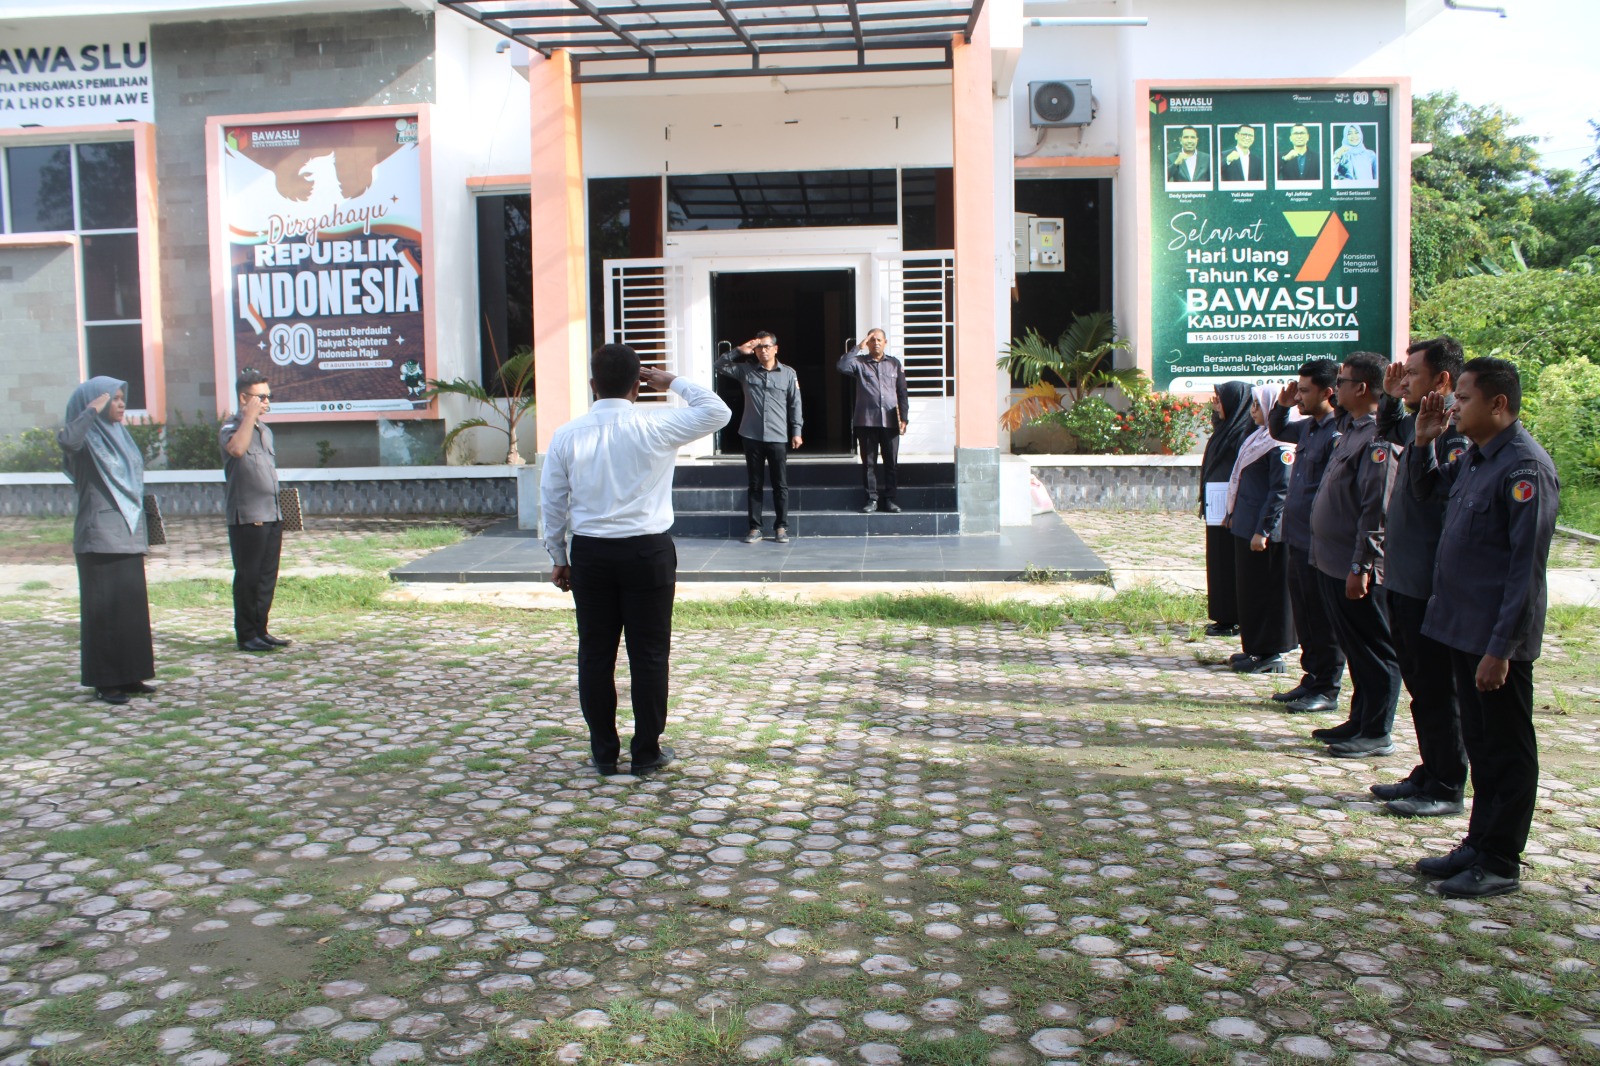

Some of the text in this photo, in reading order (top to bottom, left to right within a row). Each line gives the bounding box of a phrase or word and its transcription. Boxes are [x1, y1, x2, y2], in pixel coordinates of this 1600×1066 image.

[0, 42, 147, 74] AWASLU
[18, 80, 84, 91] PENGAWAS
[86, 76, 148, 89] PEMILIHAN
[20, 92, 149, 109] LHOKSEUMAWE
[1169, 97, 1213, 106] BAWASLU
[251, 129, 300, 141] BAWASLU
[267, 203, 388, 246] Dirgahayu
[1168, 211, 1267, 250] Selamat
[254, 238, 399, 267] REPUBLIK
[1186, 248, 1289, 266] Hari Ulang
[1186, 268, 1248, 283] Tahun
[1254, 268, 1279, 283] Ke
[237, 265, 420, 320] INDONESIA
[1186, 286, 1358, 312] BAWASLU
[1187, 311, 1359, 329] KABUPATEN/KOTA
[316, 325, 392, 337] Bersatu Berdaulat
[1248, 333, 1267, 341] 2018
[269, 322, 316, 366] 80
[317, 337, 388, 349] Rakyat Sejahtera
[317, 347, 379, 359] Indonesia Maju
[1203, 354, 1243, 363] Bersama
[1244, 354, 1276, 363] Rakyat
[1276, 353, 1304, 362] Awasi
[1170, 365, 1210, 373] Bersama
[1212, 364, 1250, 372] Bawaslu
[1251, 363, 1295, 373] Tegakkan
